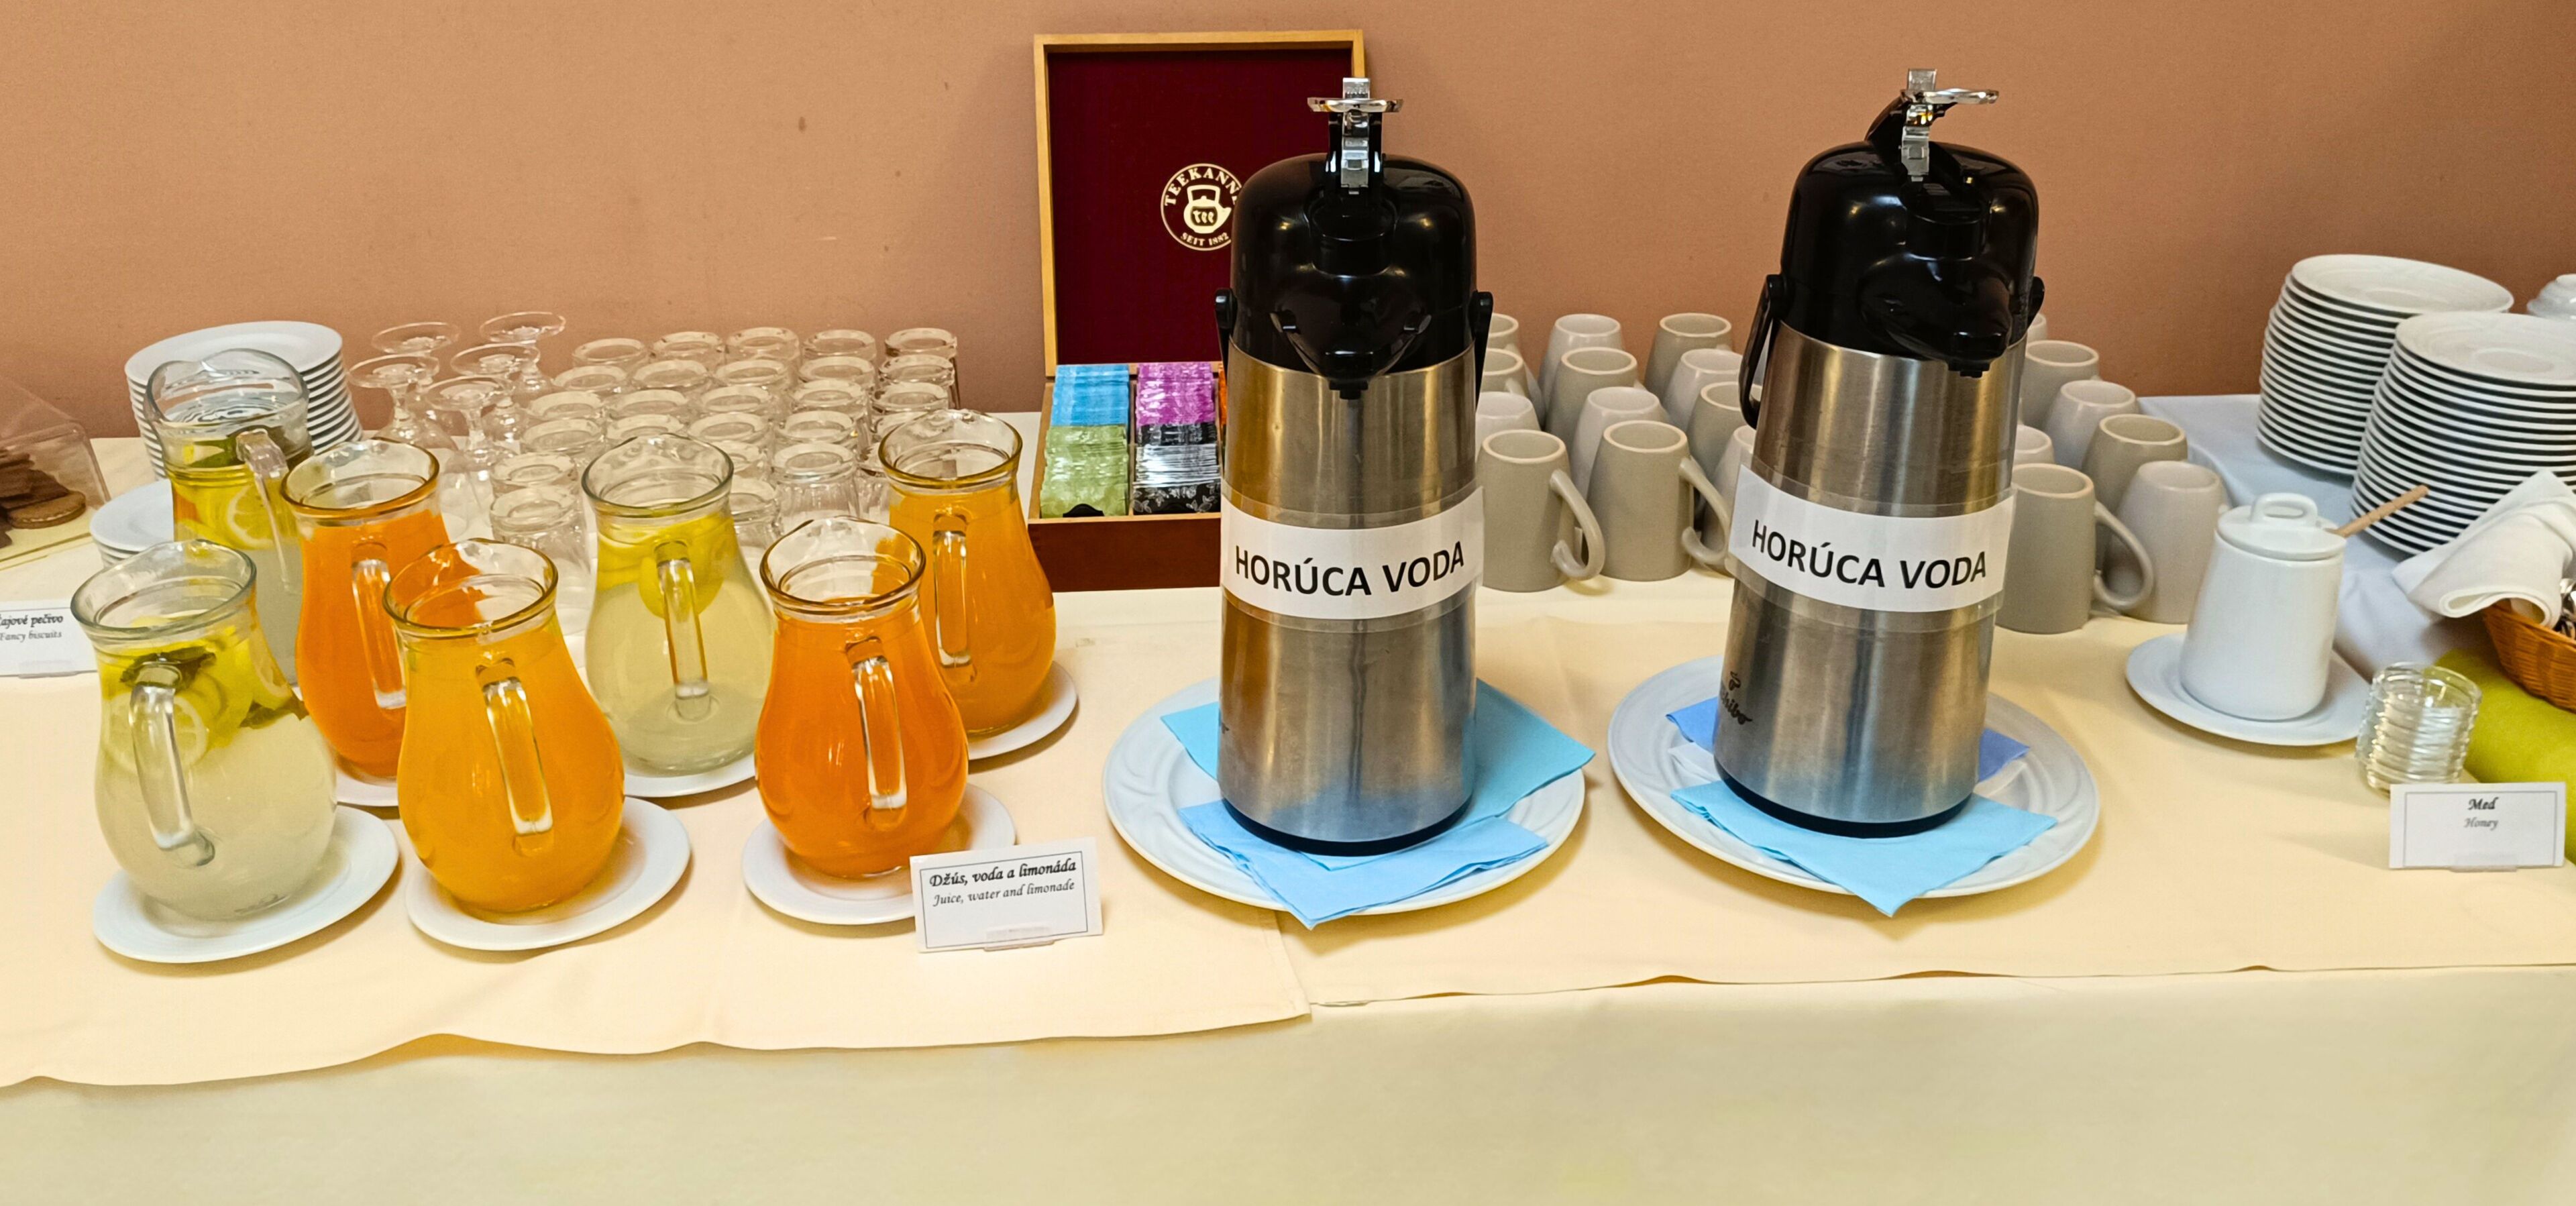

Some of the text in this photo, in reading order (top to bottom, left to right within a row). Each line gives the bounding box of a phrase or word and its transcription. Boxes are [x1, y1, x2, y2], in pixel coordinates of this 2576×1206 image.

[1181, 232, 1205, 246] SEIT
[1752, 520, 1986, 589] HORÚCA VODA
[1236, 541, 1464, 596] HORÚCA VODA
[0, 613, 64, 629] ajové pečivo
[28, 630, 62, 639] biscuits
[2468, 797, 2499, 810] Med
[2464, 817, 2498, 830] Honey
[930, 858, 1077, 887] Džús, voda a limonáda
[933, 879, 1075, 907] Juice, water and limonade
